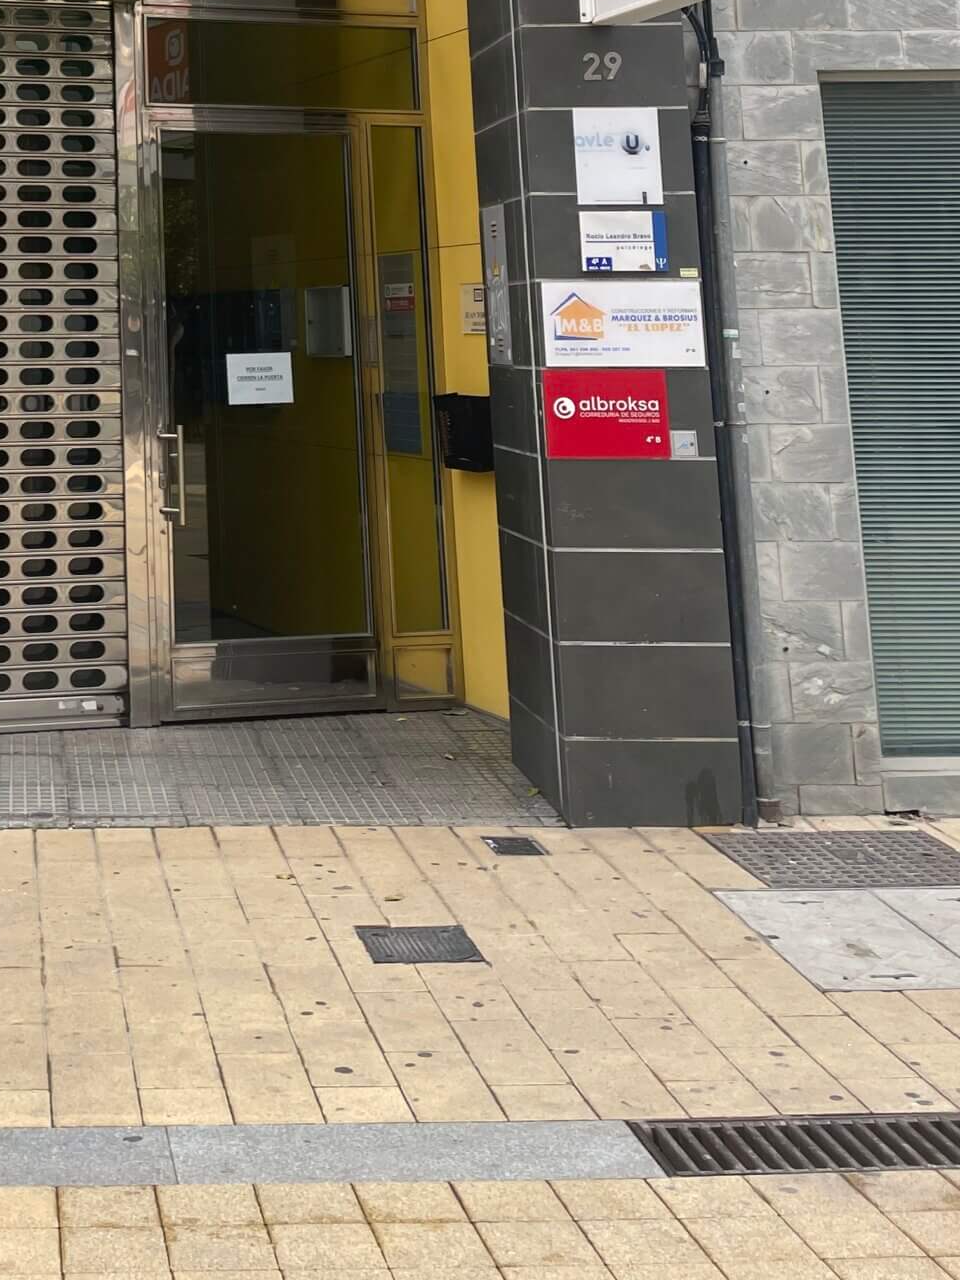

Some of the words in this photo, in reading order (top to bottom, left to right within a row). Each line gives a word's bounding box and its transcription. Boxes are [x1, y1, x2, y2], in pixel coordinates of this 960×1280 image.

[583, 51, 622, 81] 29
[561, 317, 603, 333] M&B
[611, 314, 653, 322] MARQUEZ
[662, 314, 698, 322] BROSIUS
[579, 396, 659, 411] albroksa
